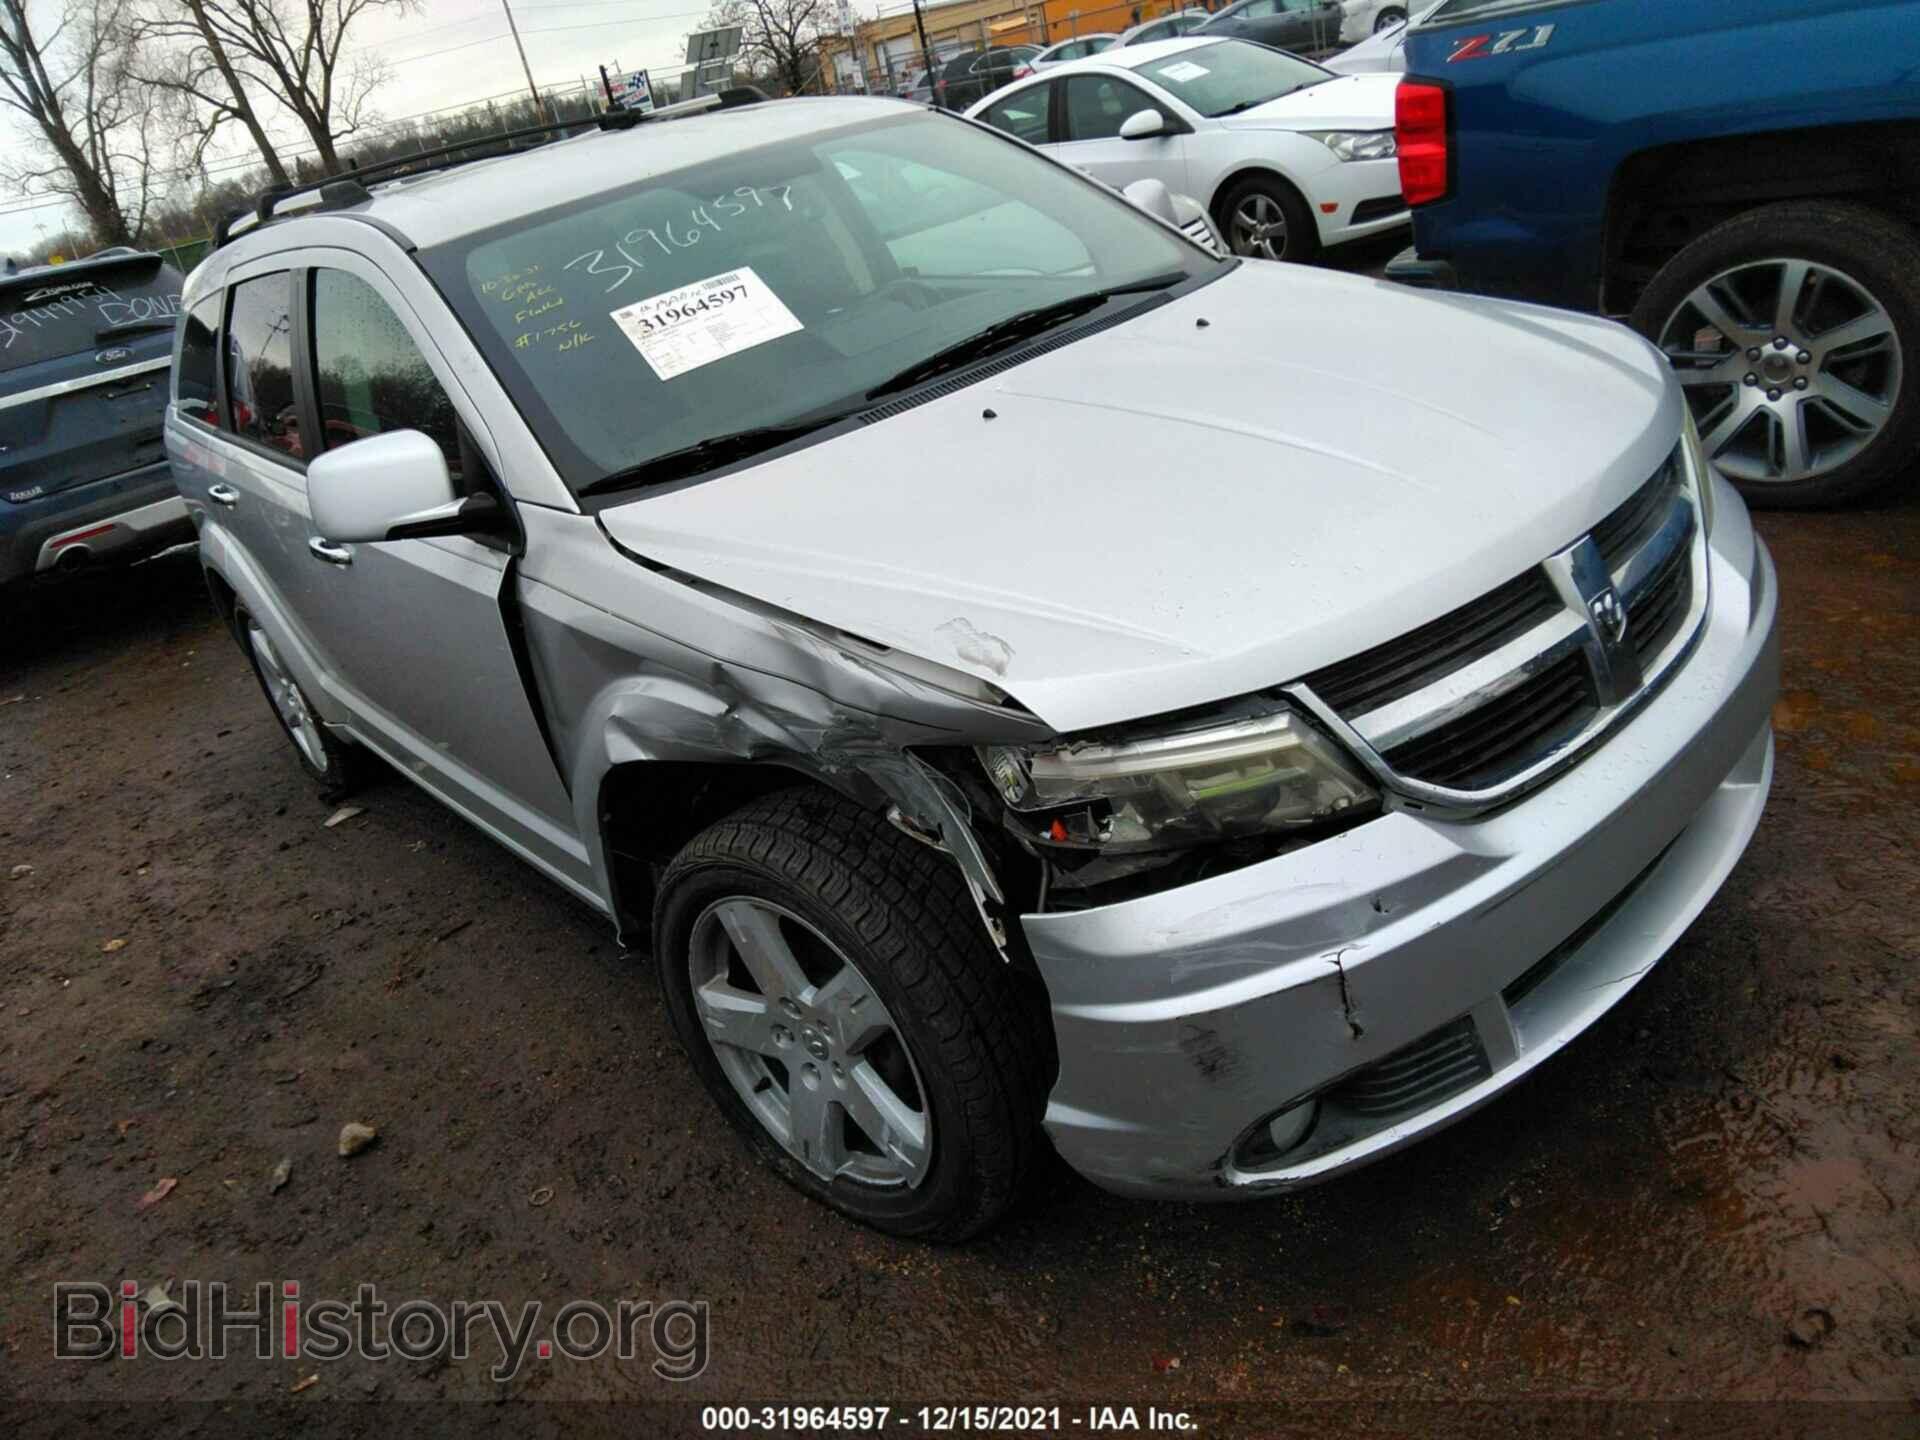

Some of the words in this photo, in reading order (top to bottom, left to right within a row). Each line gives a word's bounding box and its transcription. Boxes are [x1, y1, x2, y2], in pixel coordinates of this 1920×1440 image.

[1446, 24, 1555, 63] Z71
[563, 185, 793, 294] 31964597
[638, 284, 749, 334] 31964597
